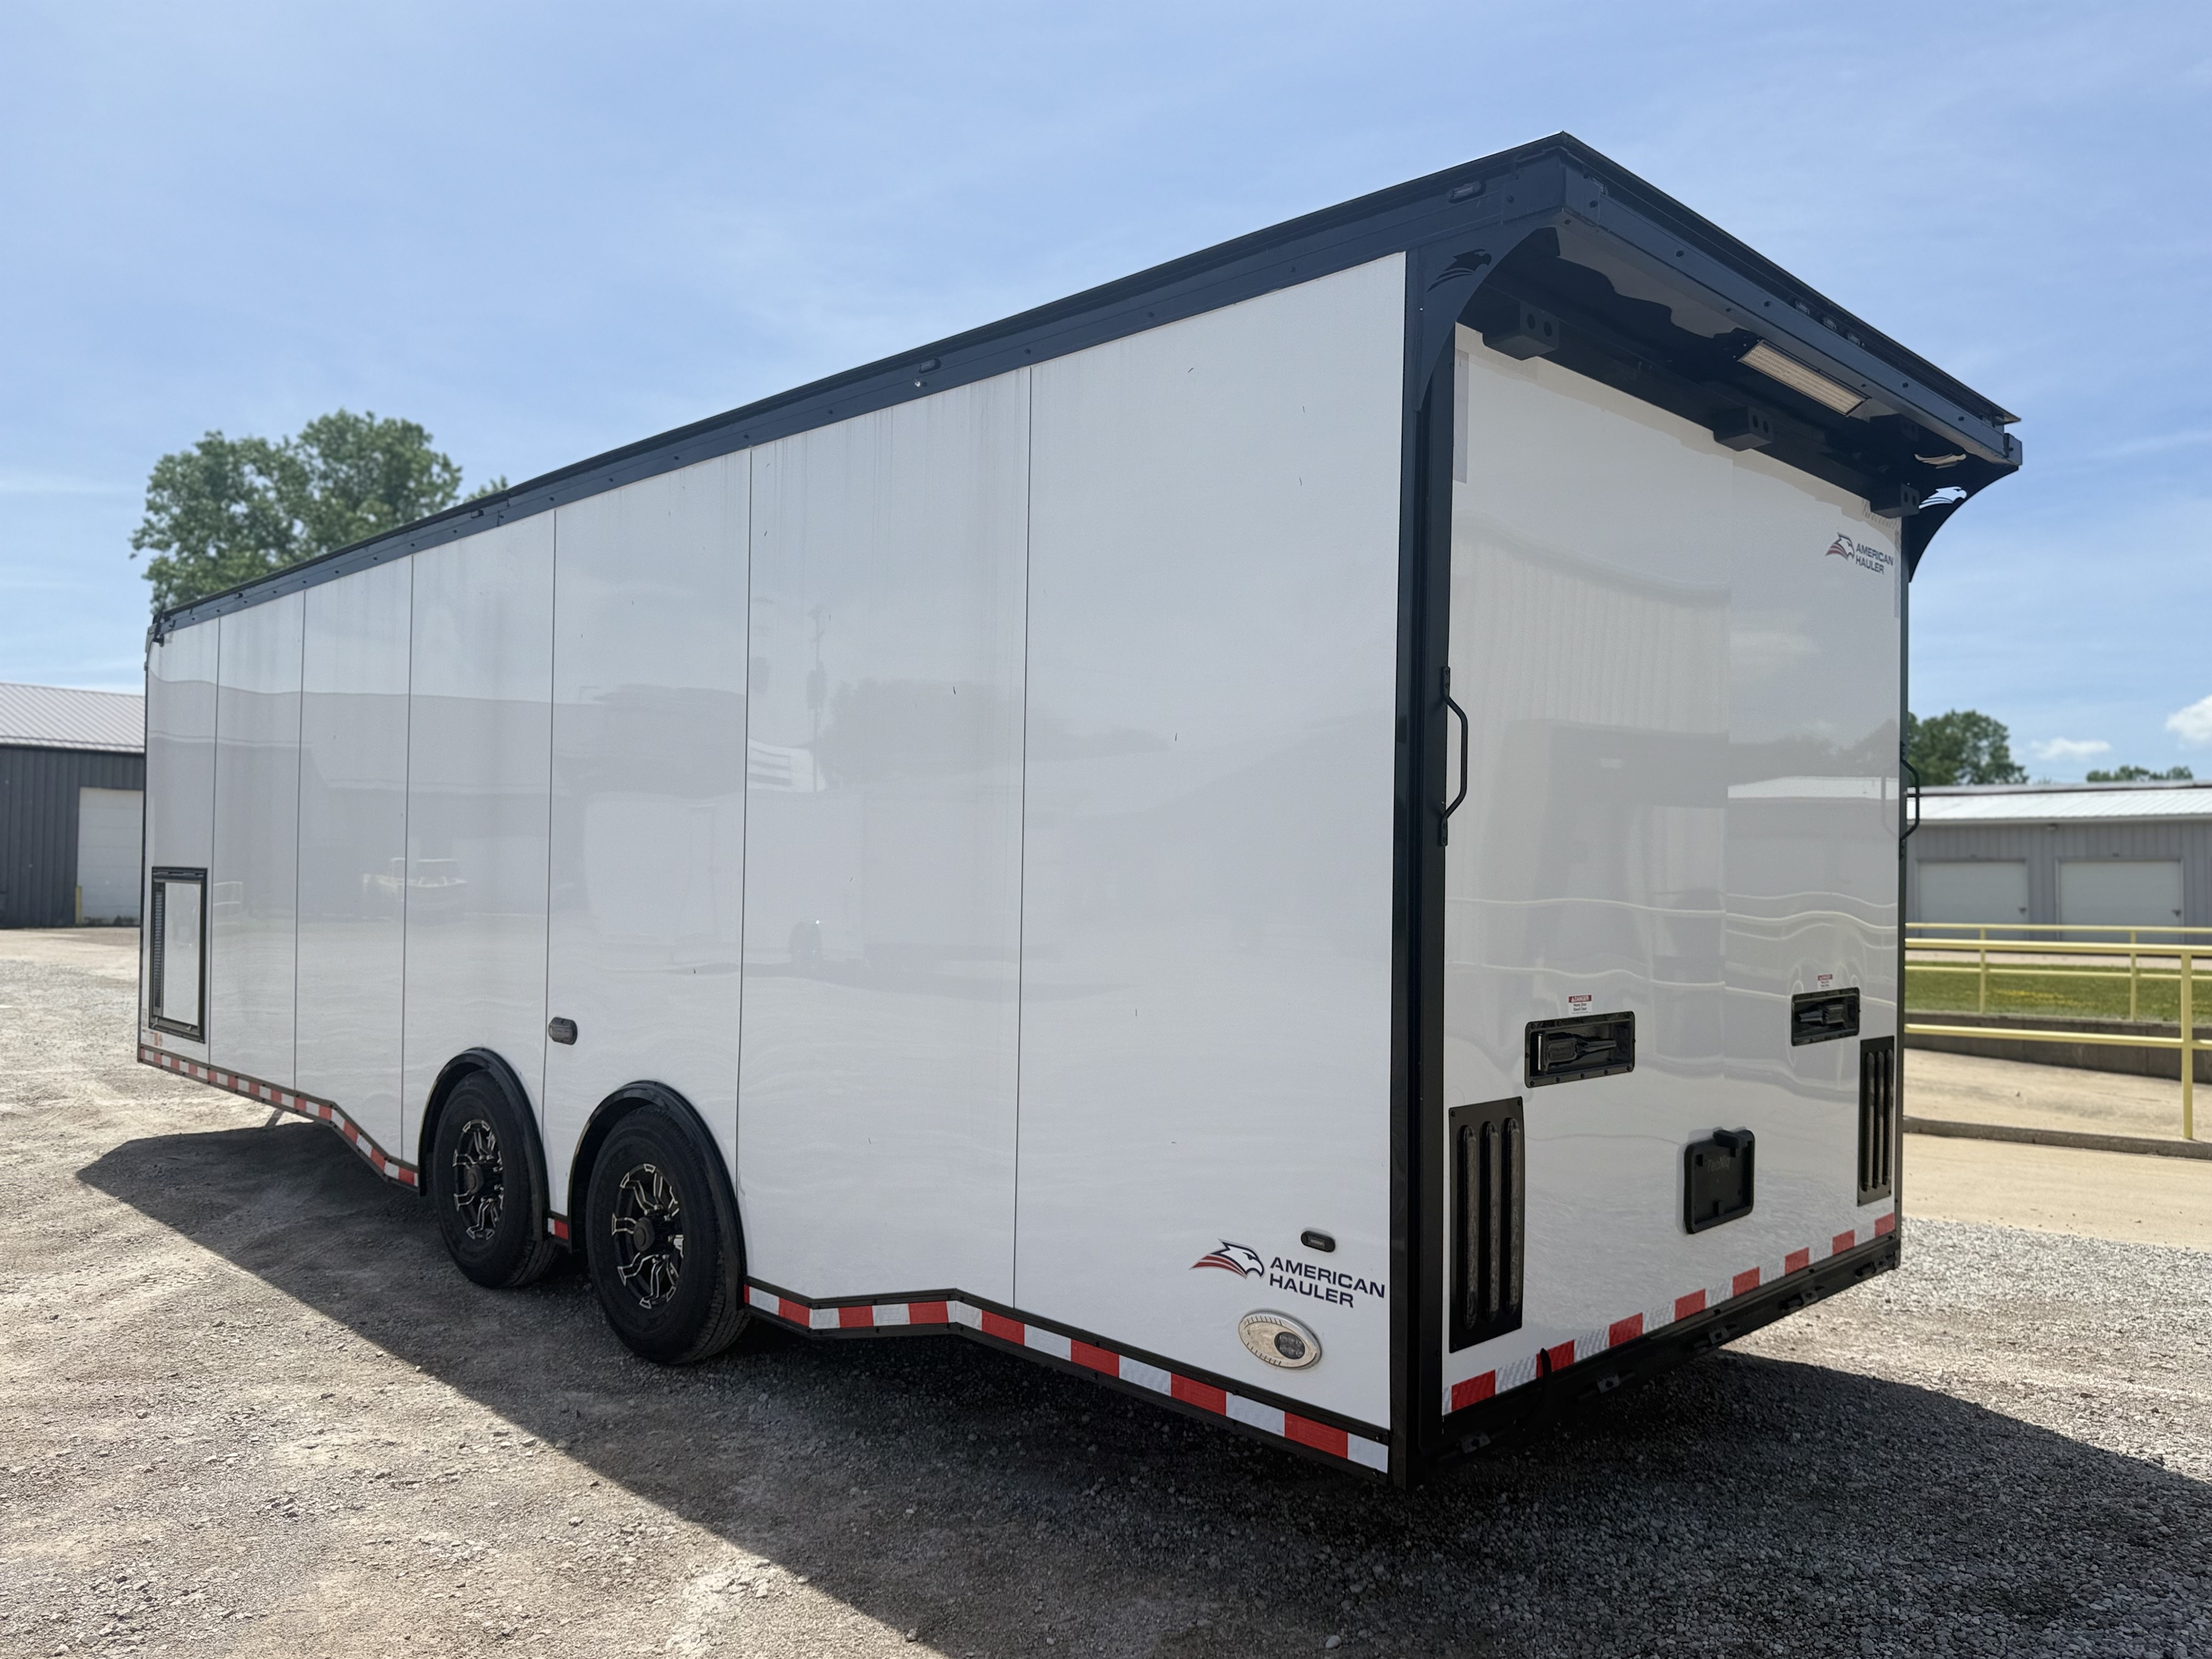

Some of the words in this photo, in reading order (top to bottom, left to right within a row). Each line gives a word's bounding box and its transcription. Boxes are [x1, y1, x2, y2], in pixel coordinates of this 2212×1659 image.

[1855, 555, 1884, 574] HAULER
[1856, 543, 1894, 566] AMERICAN
[1269, 1273, 1354, 1308] HAULER
[1270, 1257, 1385, 1298] AMERICAN
